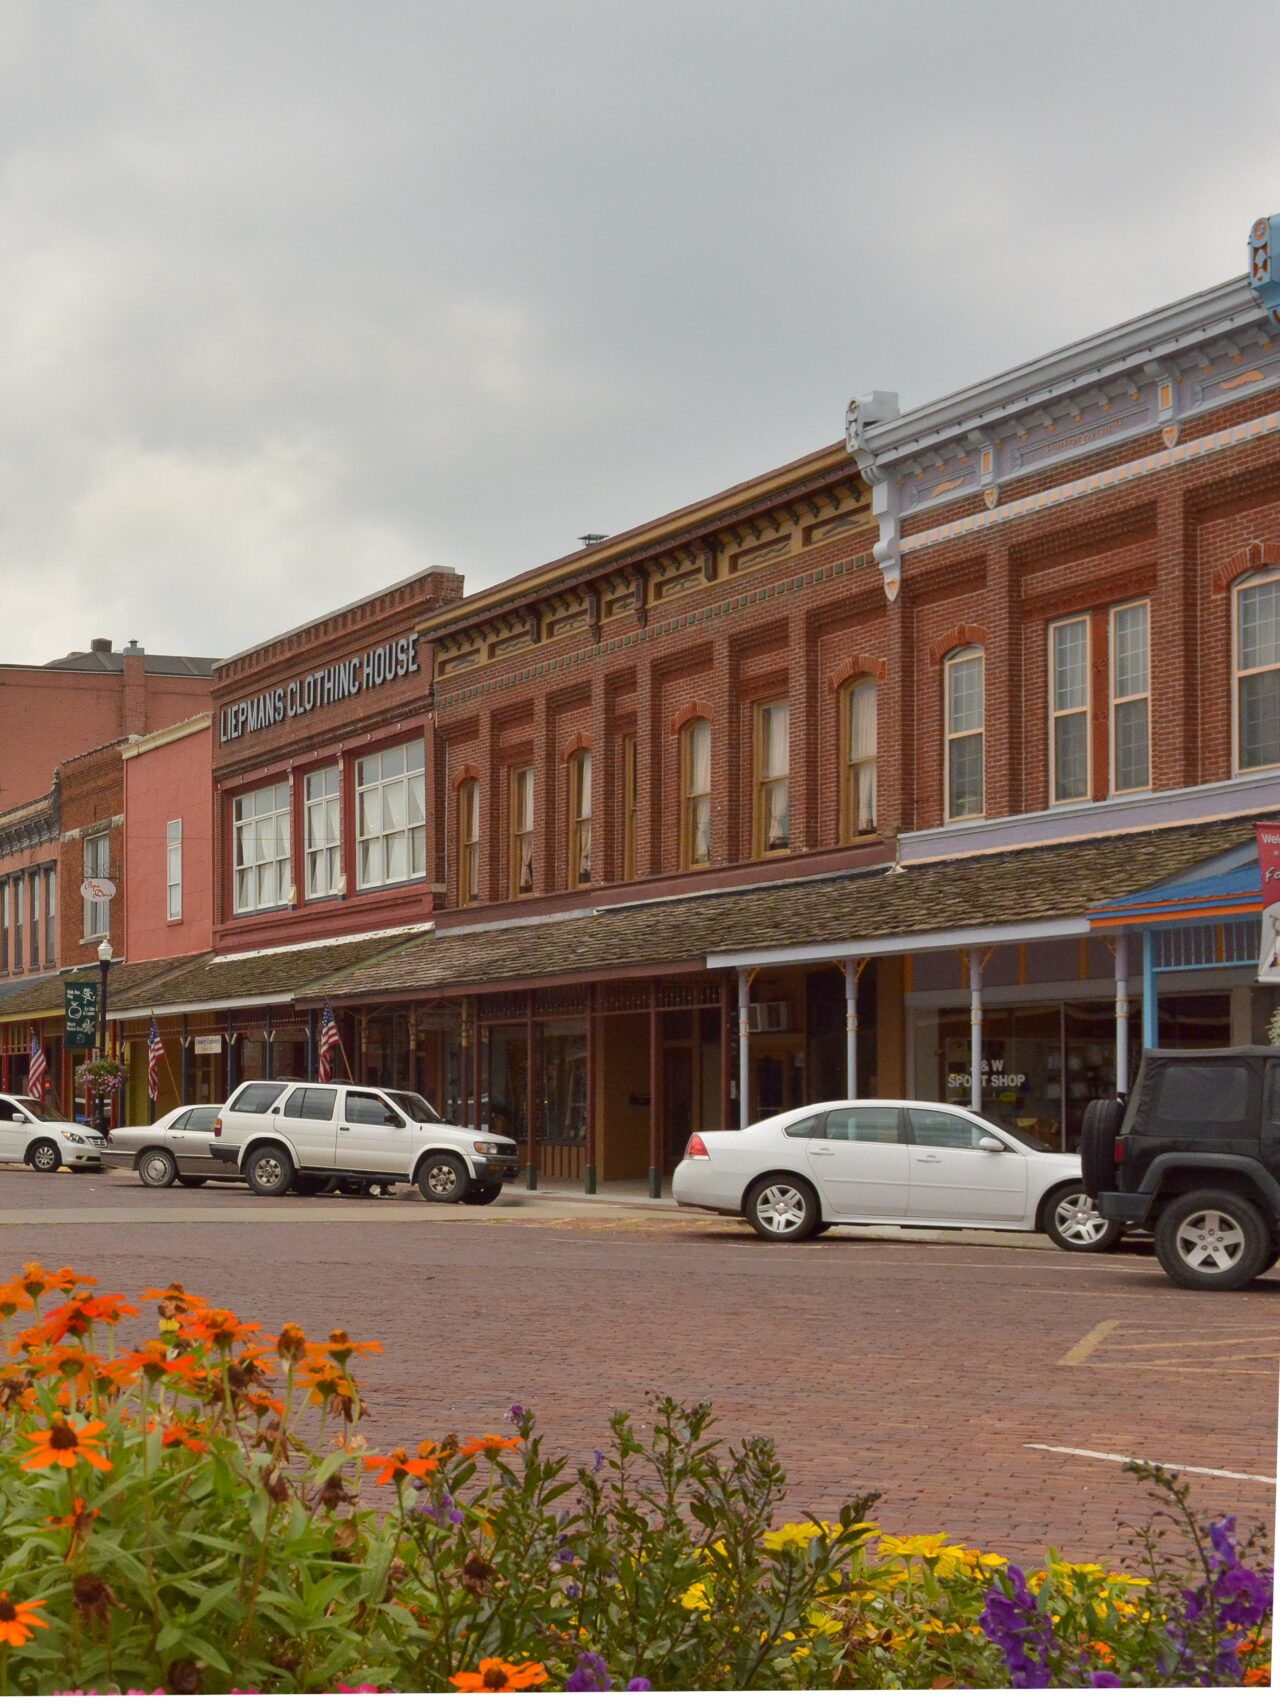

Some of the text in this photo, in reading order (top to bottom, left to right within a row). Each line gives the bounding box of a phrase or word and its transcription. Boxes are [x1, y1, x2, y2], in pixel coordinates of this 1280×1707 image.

[220, 633, 418, 741] LIEPMANS CLOTHING HOUSE
[991, 1059, 1004, 1072] W
[948, 1074, 1026, 1088] SPOT SHOP
